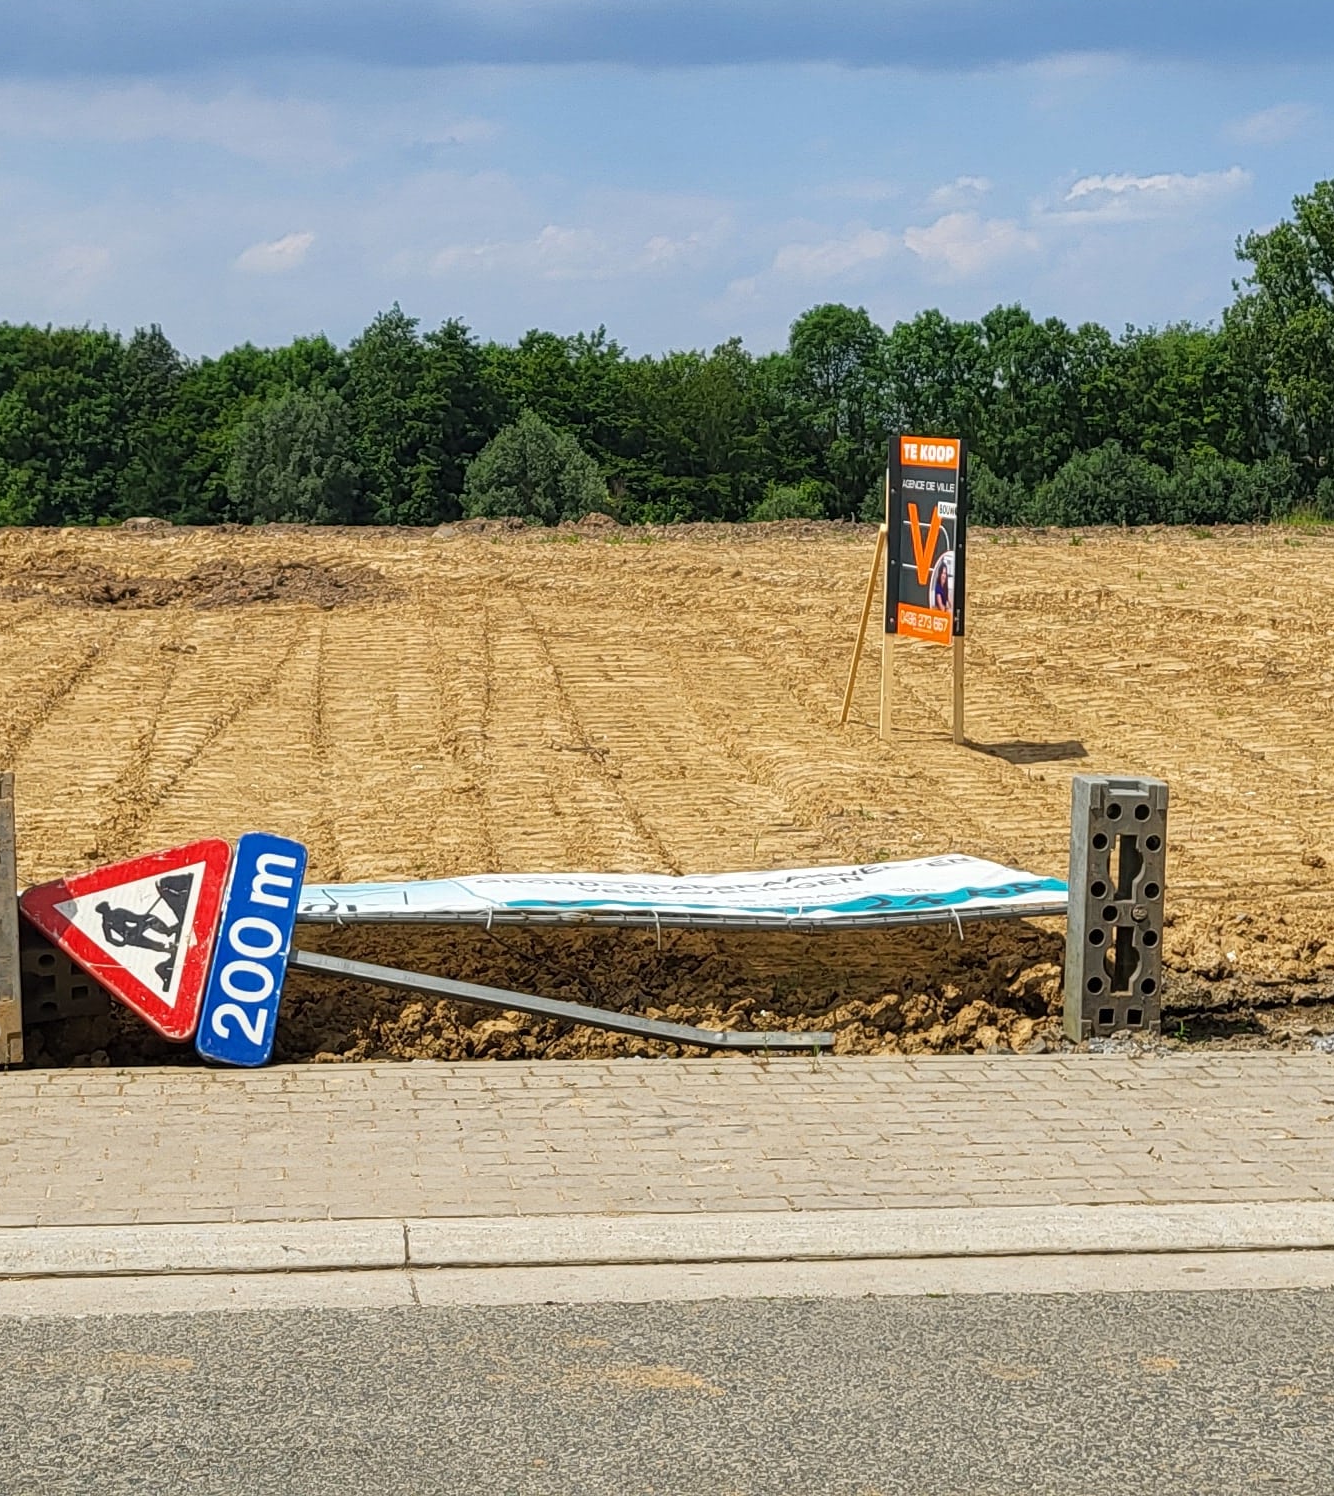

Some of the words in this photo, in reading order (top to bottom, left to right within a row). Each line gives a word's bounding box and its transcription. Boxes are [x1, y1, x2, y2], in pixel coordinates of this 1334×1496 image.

[903, 444, 917, 460] TE
[920, 444, 955, 463] KOOP
[902, 479, 925, 490] AGENCE
[926, 481, 935, 491] DE
[936, 481, 955, 493] VILLE
[918, 613, 932, 629] 273
[933, 616, 948, 633] 667
[210, 916, 284, 1047] 200
[250, 852, 297, 909] m
